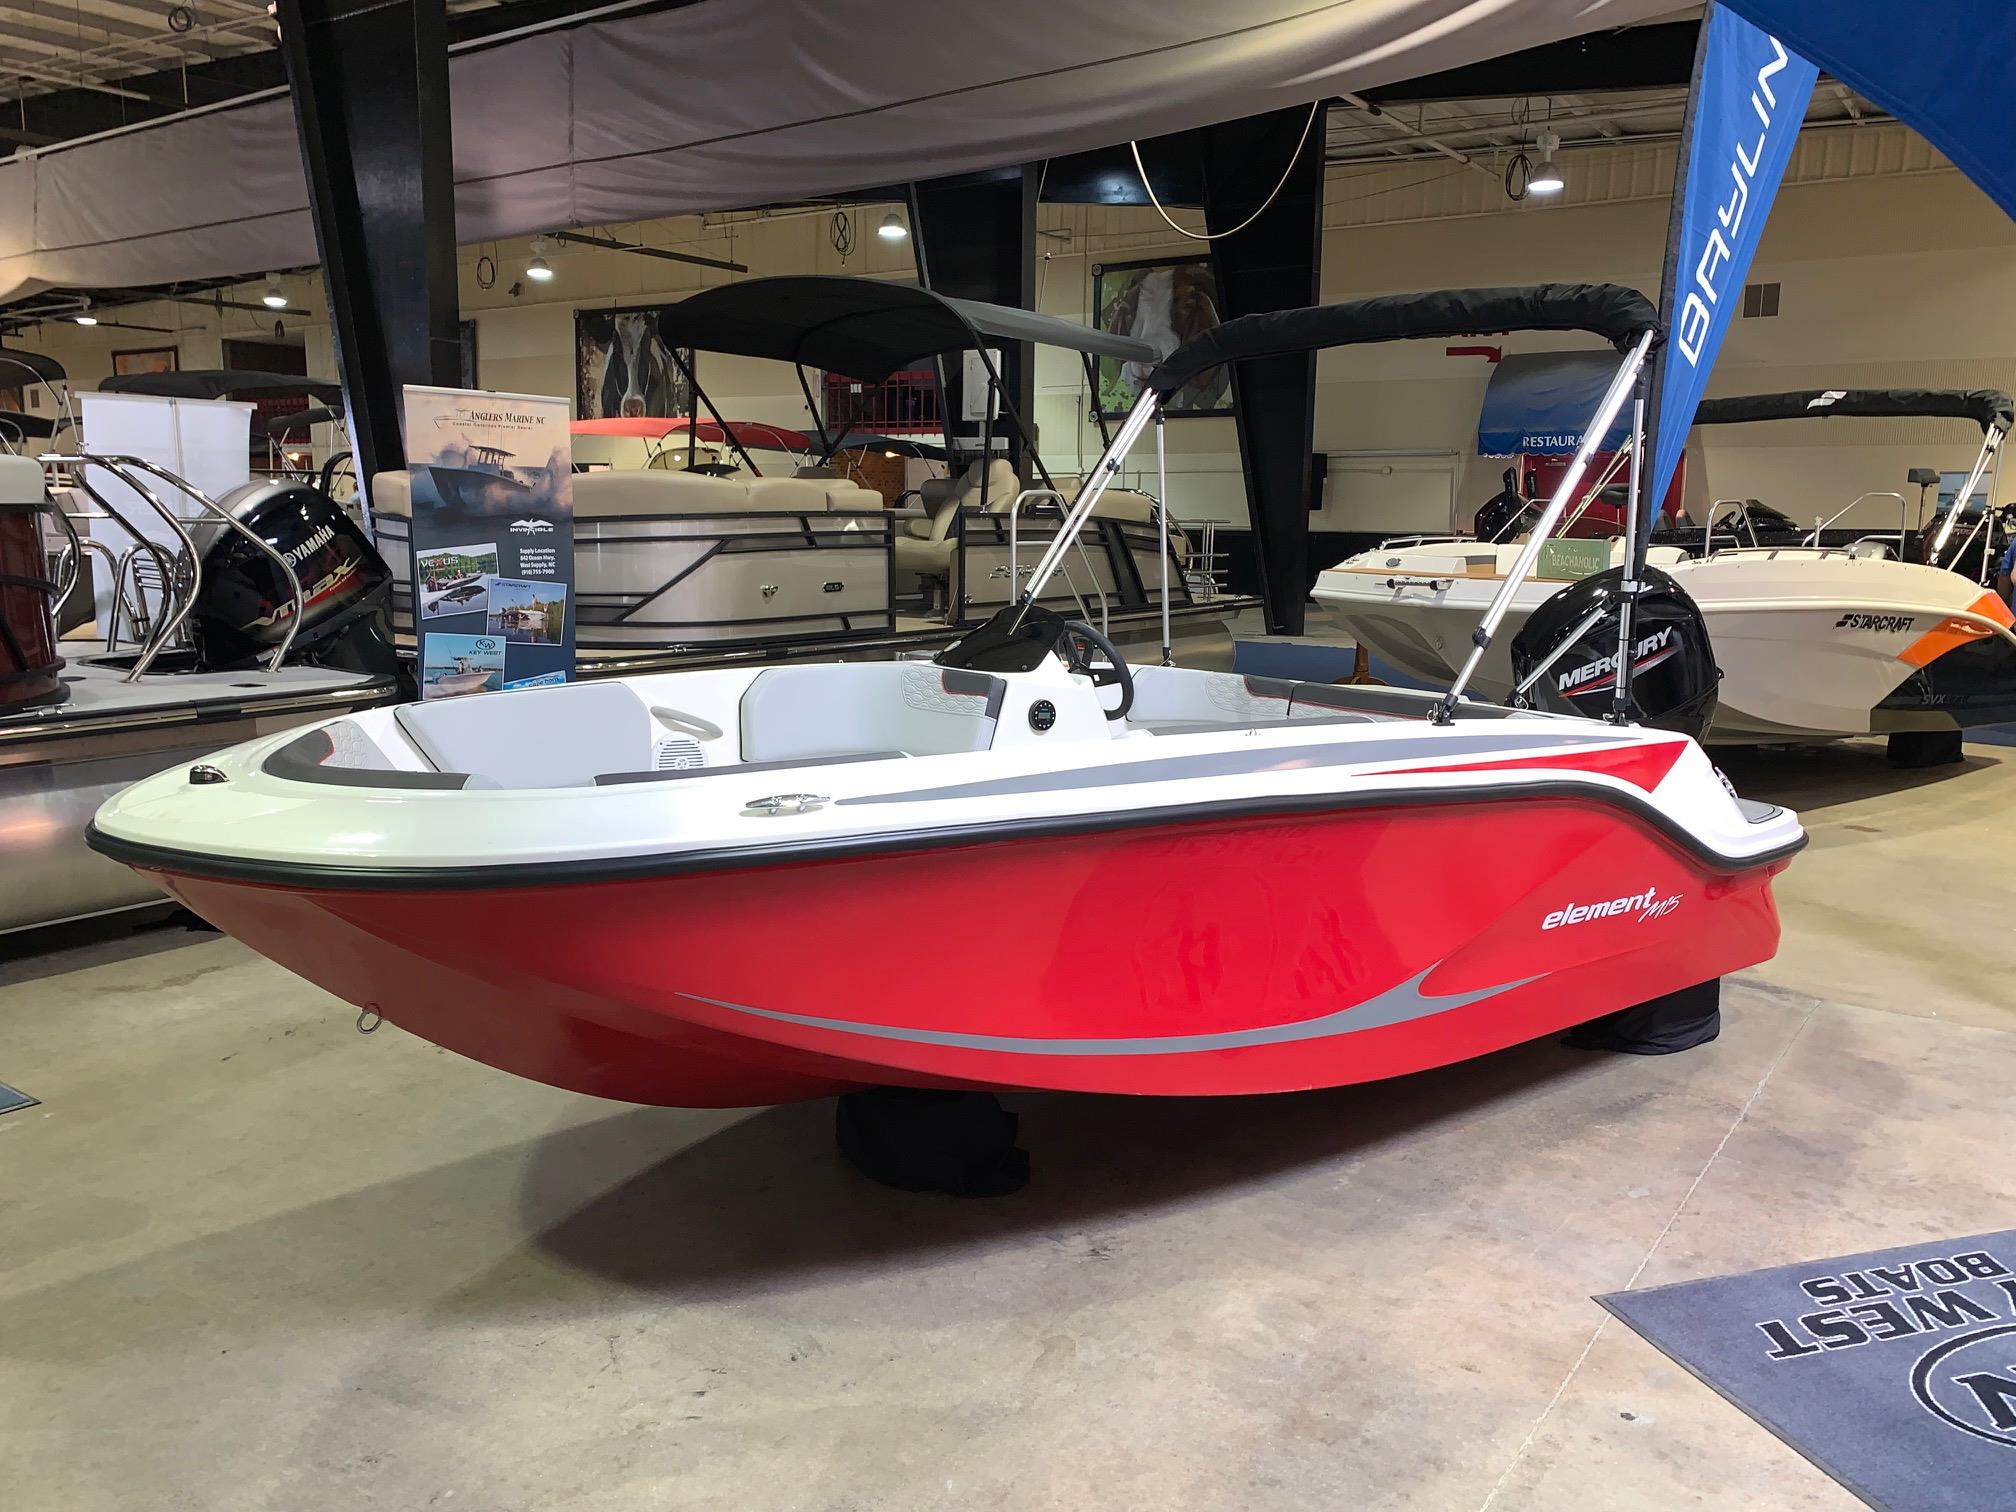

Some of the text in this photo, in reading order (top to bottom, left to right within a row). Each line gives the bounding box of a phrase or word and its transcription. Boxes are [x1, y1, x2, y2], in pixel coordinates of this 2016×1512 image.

[505, 412, 535, 425] MARINE
[292, 524, 336, 561] YAMAHA
[1552, 554, 1600, 570] BEACHAHOLIC
[1849, 614, 1915, 632] STARCRAFT
[1541, 886, 1657, 931] element
[1799, 1250, 2014, 1307] BOATS
[1755, 1289, 2001, 1361] WEST
